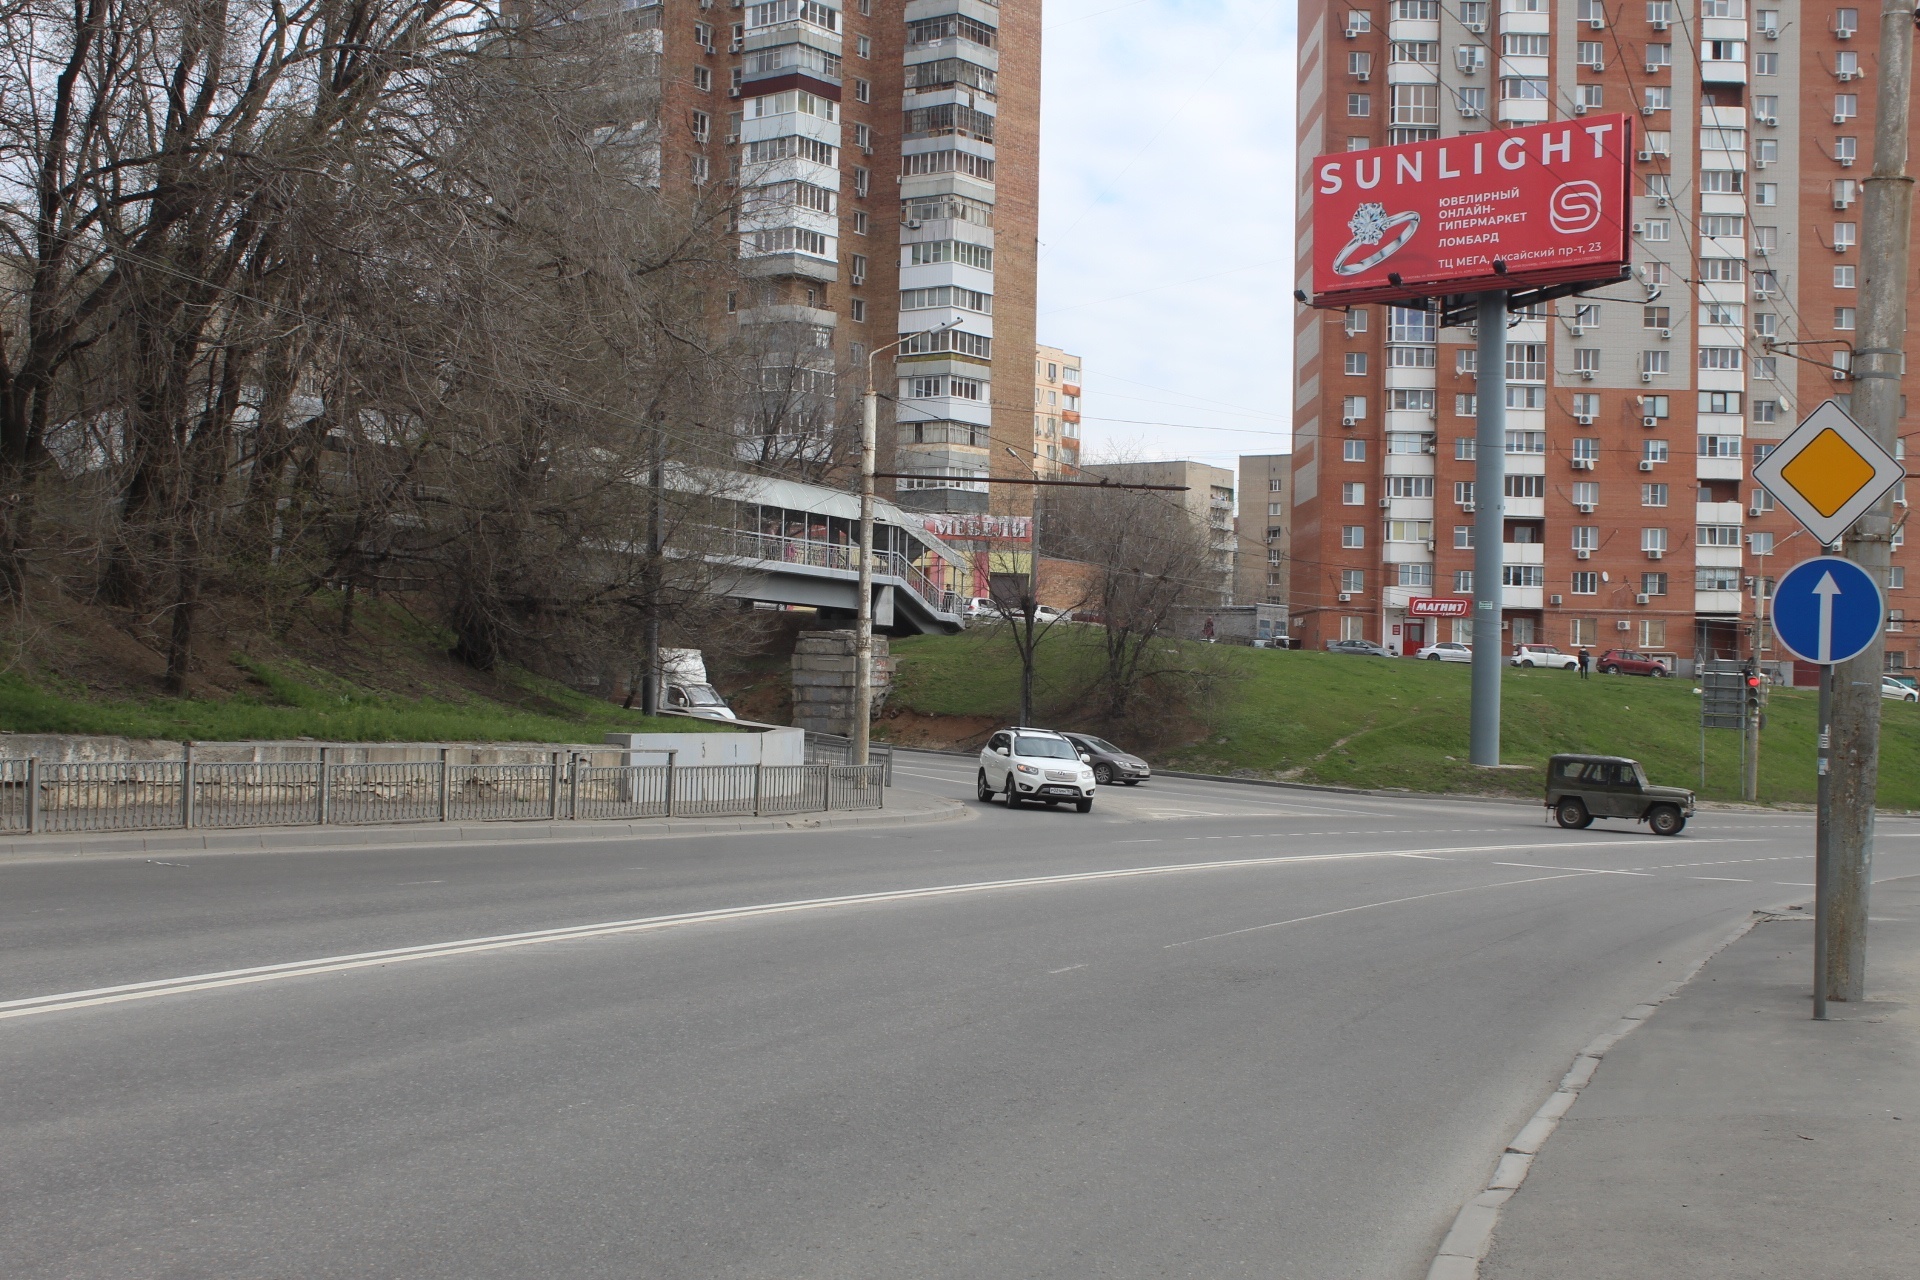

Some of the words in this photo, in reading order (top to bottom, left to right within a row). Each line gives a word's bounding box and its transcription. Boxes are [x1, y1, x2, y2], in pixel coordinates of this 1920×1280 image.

[1319, 123, 1613, 195] SUNLIGHT
[1438, 186, 1520, 208] ЮВЕЛИРНЫЙ
[1438, 203, 1496, 219] ОНЛАЙН-
[1438, 212, 1528, 232] ГИПЕРМАРКЕТ
[1438, 232, 1500, 248] ЛОМБАРД
[1438, 258, 1453, 269] ТЦ
[1456, 254, 1490, 267] МЕГА,
[1493, 246, 1555, 262] Аксайский
[1558, 245, 1586, 257] пр-т,
[1588, 241, 1602, 252] 23
[933, 518, 1028, 538] МЕБЕЛИ
[1416, 602, 1464, 612] МАГНИТ
